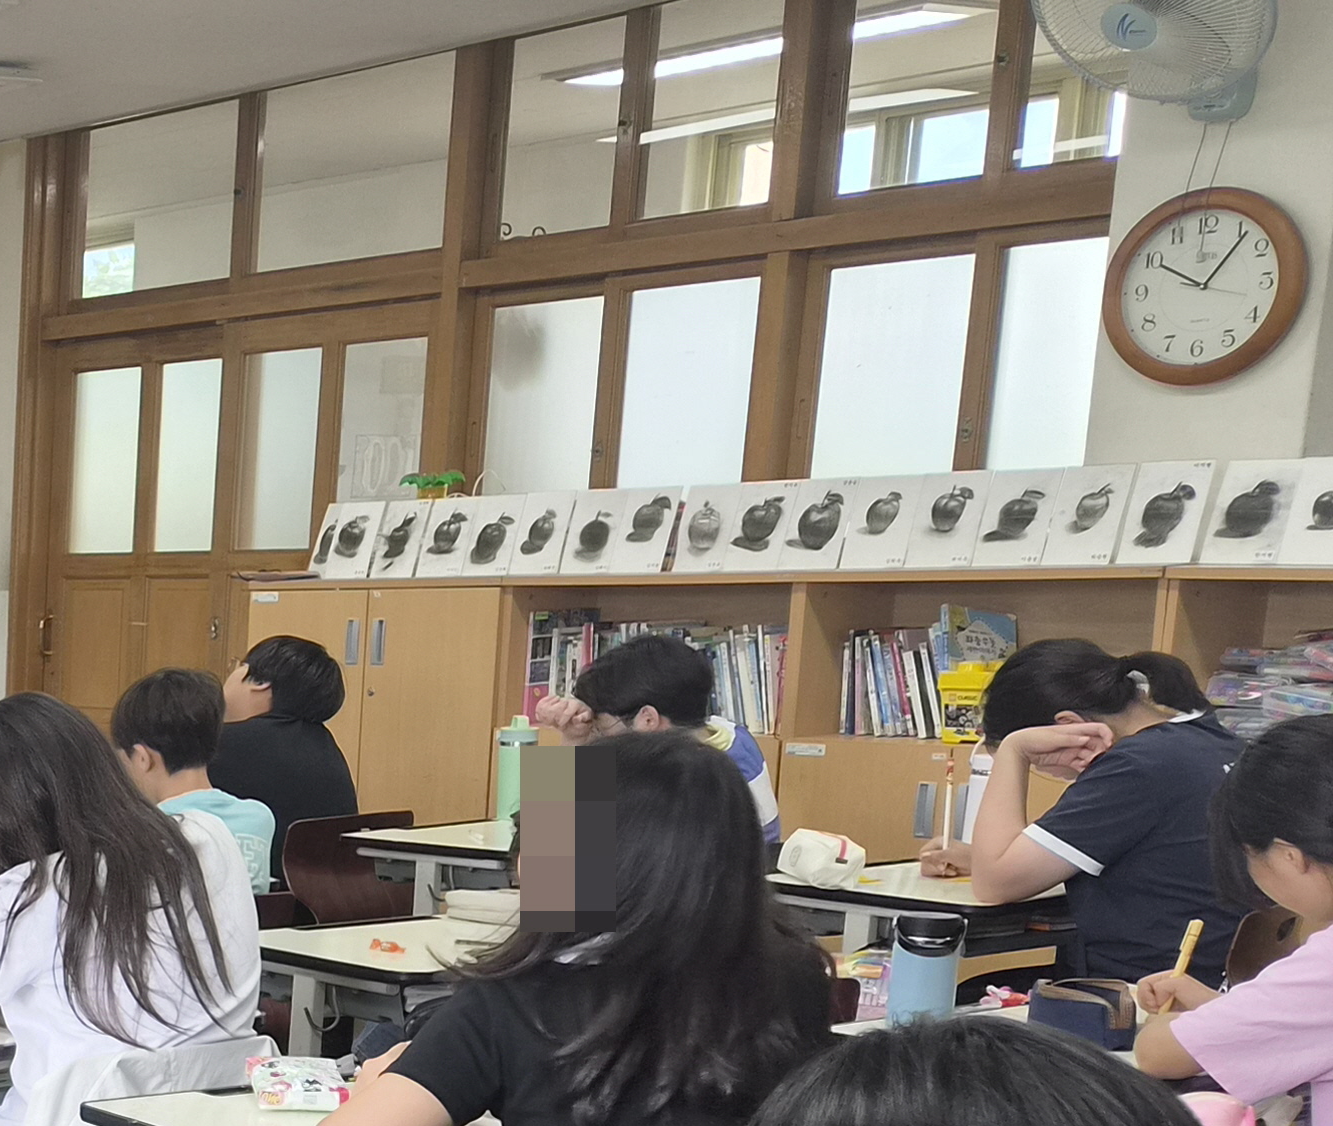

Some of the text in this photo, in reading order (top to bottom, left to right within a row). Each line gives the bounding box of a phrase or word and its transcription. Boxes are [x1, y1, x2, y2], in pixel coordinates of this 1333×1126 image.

[1199, 215, 1219, 235] 12
[1171, 226, 1183, 245] 11
[1254, 238, 1269, 258] 2
[1145, 251, 1163, 269] 10
[1259, 272, 1274, 290] 3
[1135, 284, 1148, 302] 9
[1141, 313, 1156, 331] 8
[1244, 305, 1260, 323] 4
[1164, 335, 1176, 352] 7
[1221, 329, 1236, 347] 5
[1190, 339, 1203, 358] 6
